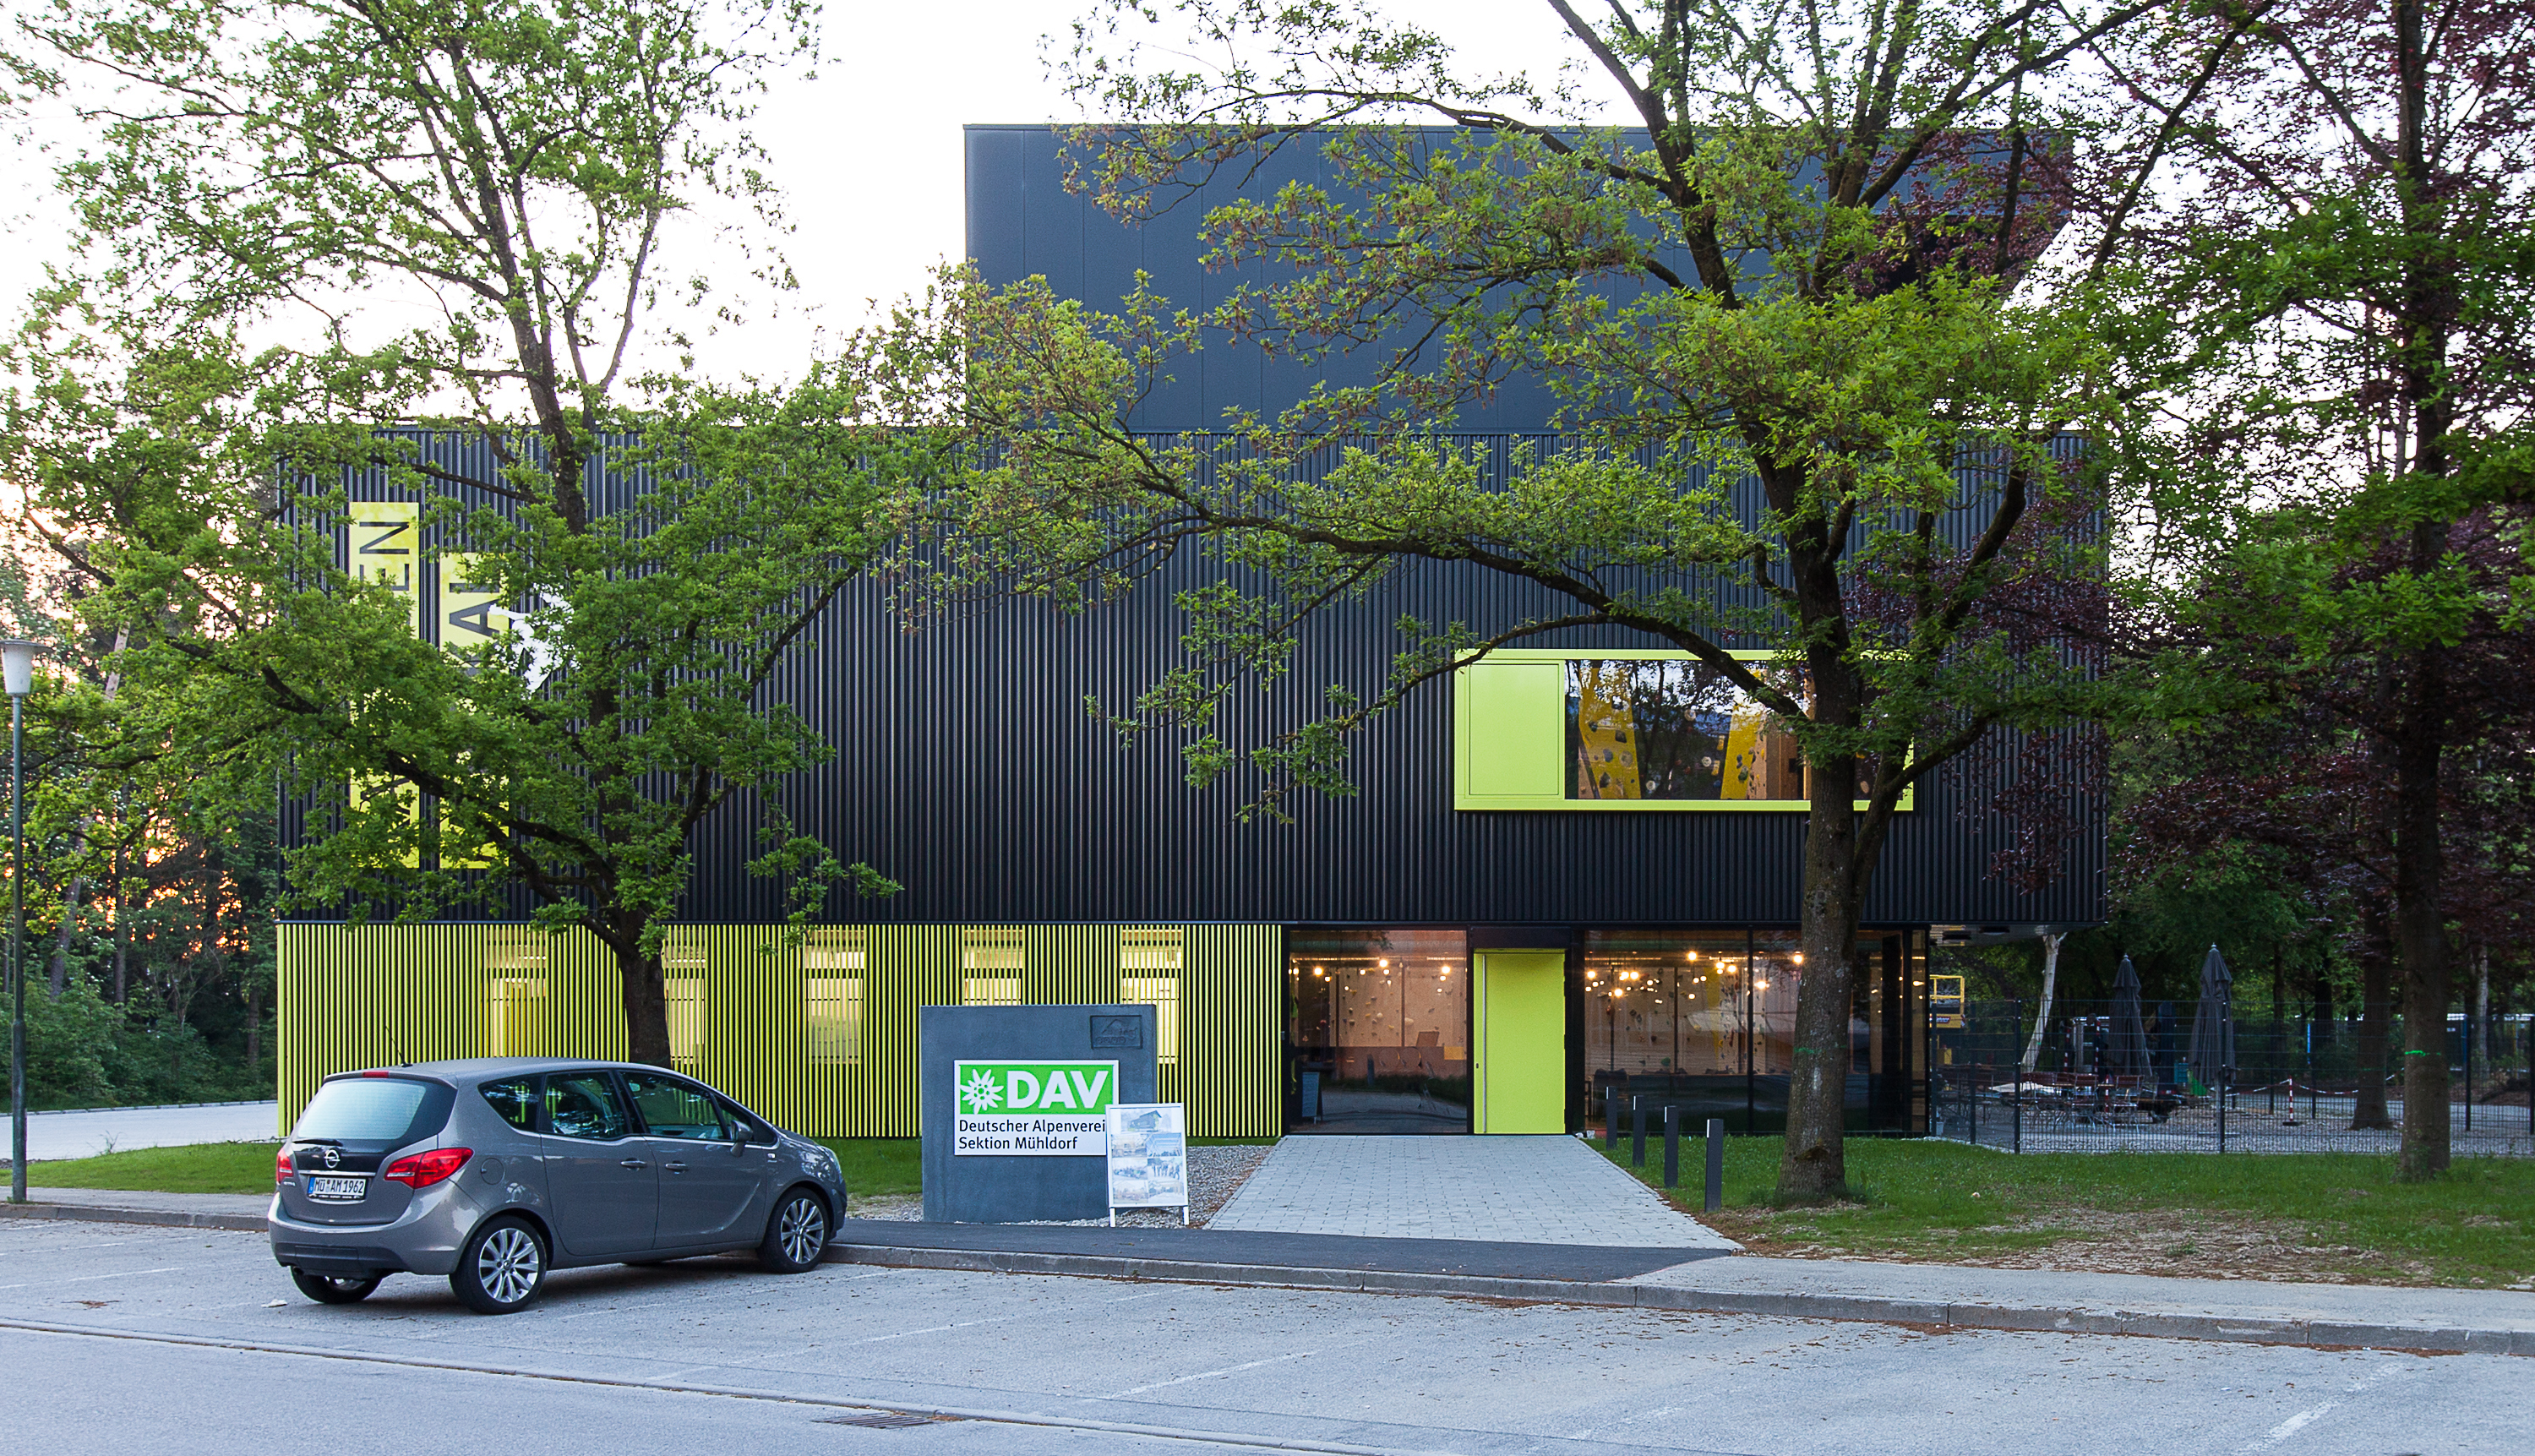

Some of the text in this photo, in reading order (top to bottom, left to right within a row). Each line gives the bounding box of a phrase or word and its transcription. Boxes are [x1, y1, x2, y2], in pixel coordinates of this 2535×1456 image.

[1007, 1070, 1109, 1109] DAV
[959, 1120, 1105, 1135] Deutscher Alpenverei
[959, 1137, 1077, 1149] Sektion Mühldorf
[314, 1179, 364, 1193] MÜ AM 1962
